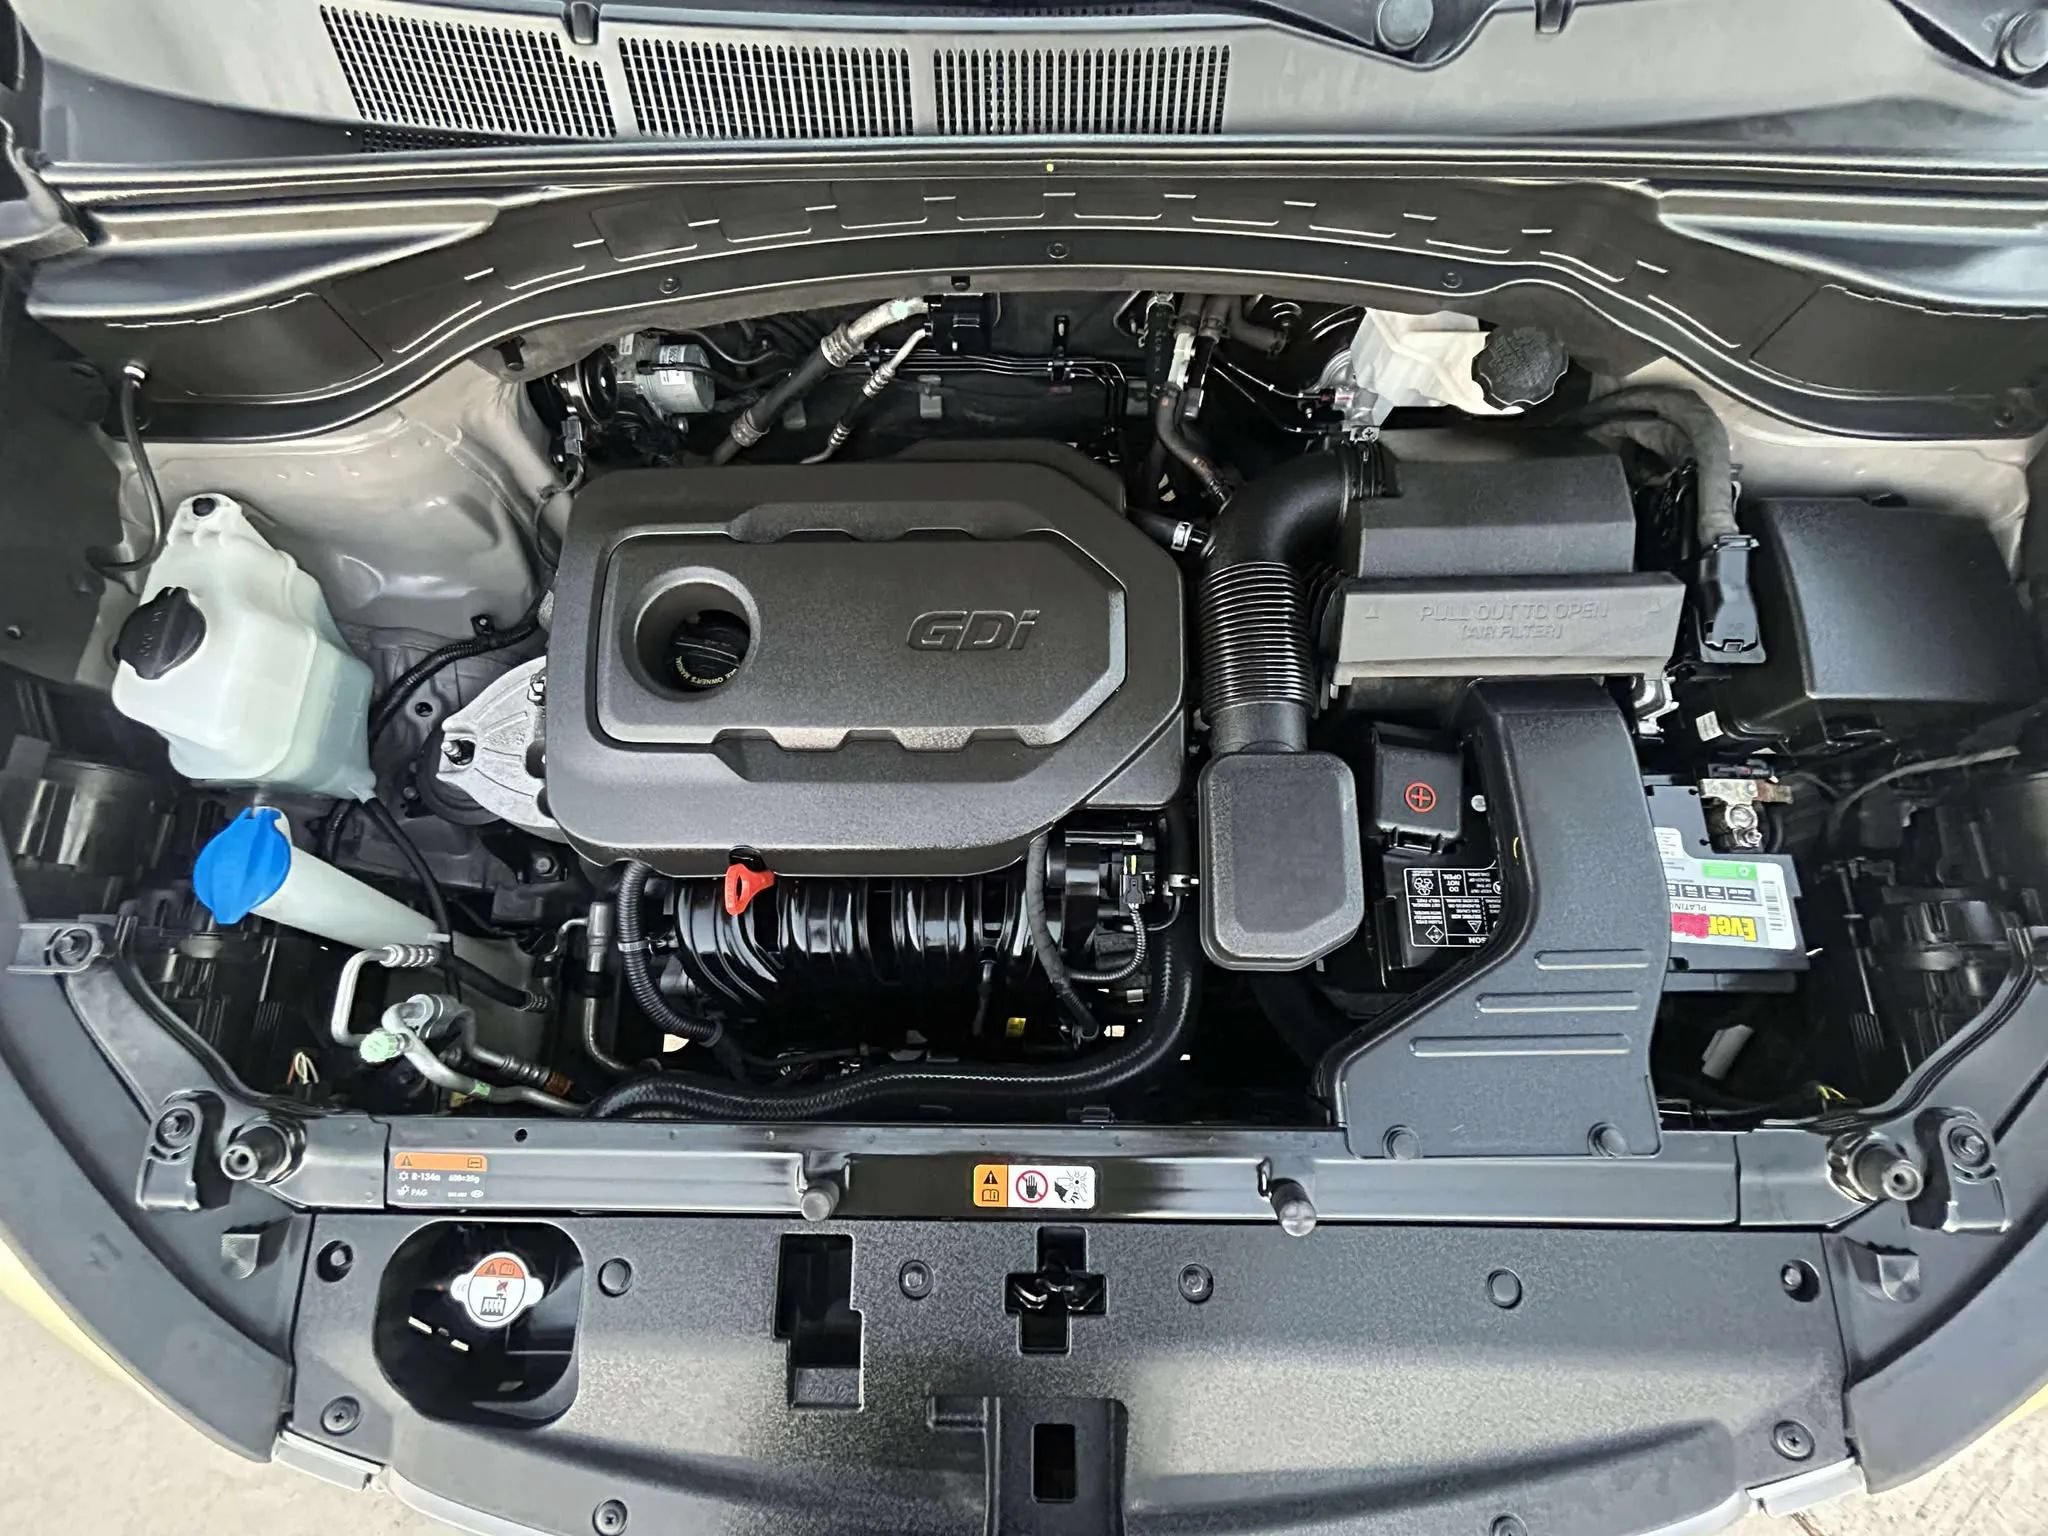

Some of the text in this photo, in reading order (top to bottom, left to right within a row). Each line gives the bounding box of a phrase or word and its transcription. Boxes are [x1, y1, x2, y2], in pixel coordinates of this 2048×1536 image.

[1421, 603, 1609, 621] PULL OUT TO OPEN
[906, 609, 1040, 651] GDi
[1501, 624, 1563, 639] FILTER)
[410, 1187, 429, 1197] PAG
